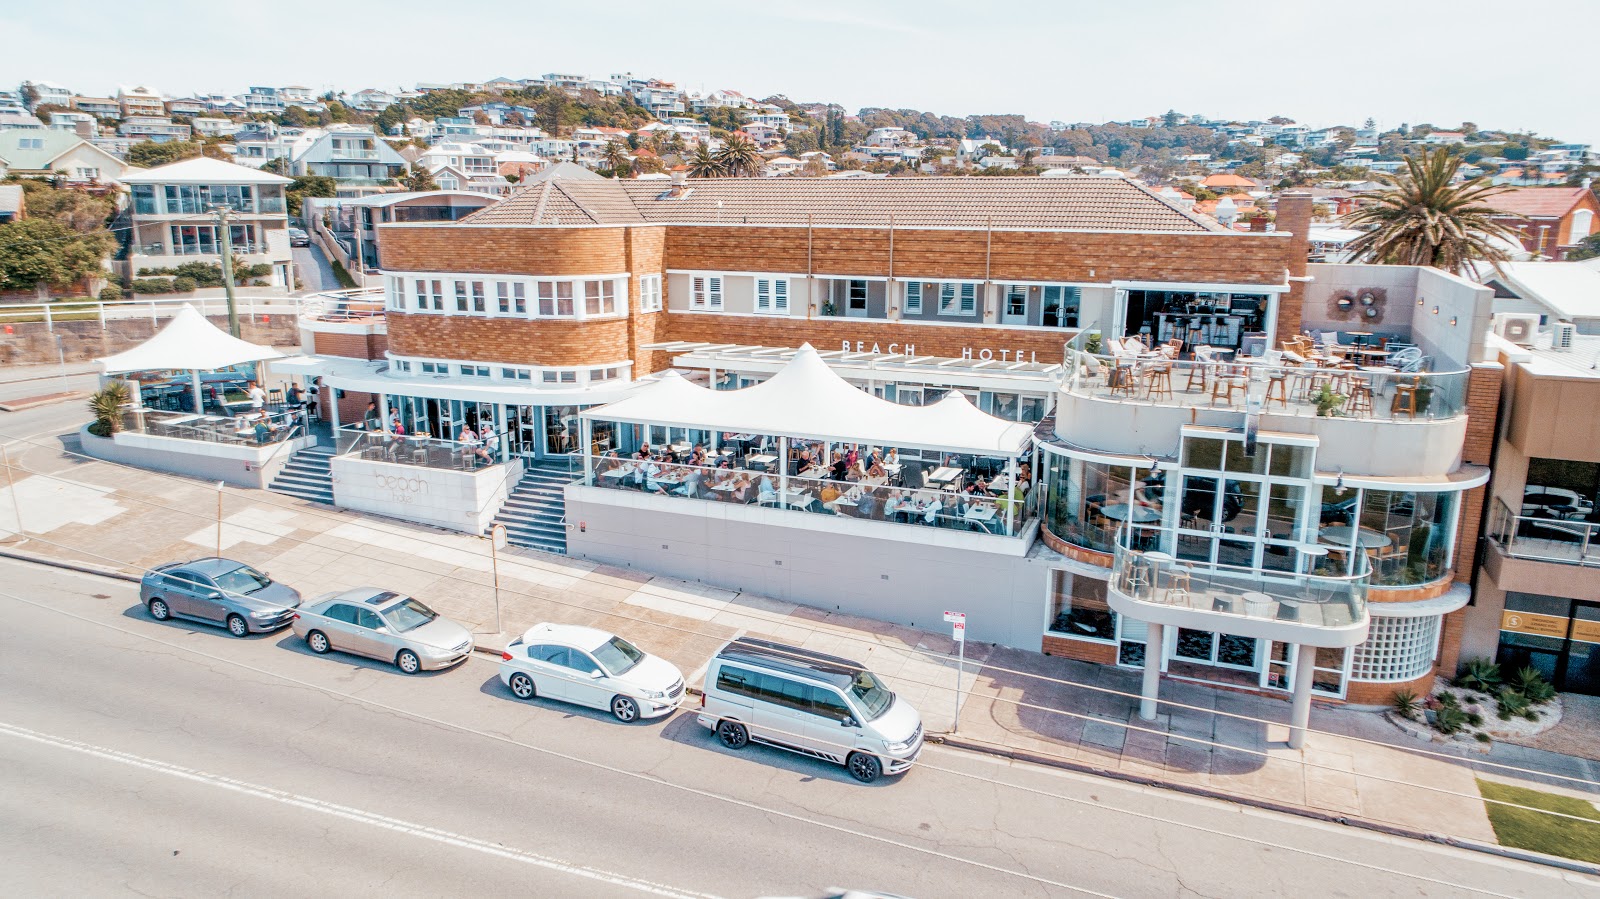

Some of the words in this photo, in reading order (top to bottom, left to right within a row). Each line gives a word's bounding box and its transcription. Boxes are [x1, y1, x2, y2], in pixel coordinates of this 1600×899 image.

[842, 340, 915, 357] BEACH
[962, 347, 1039, 365] HOTEL
[375, 469, 429, 495] beach
